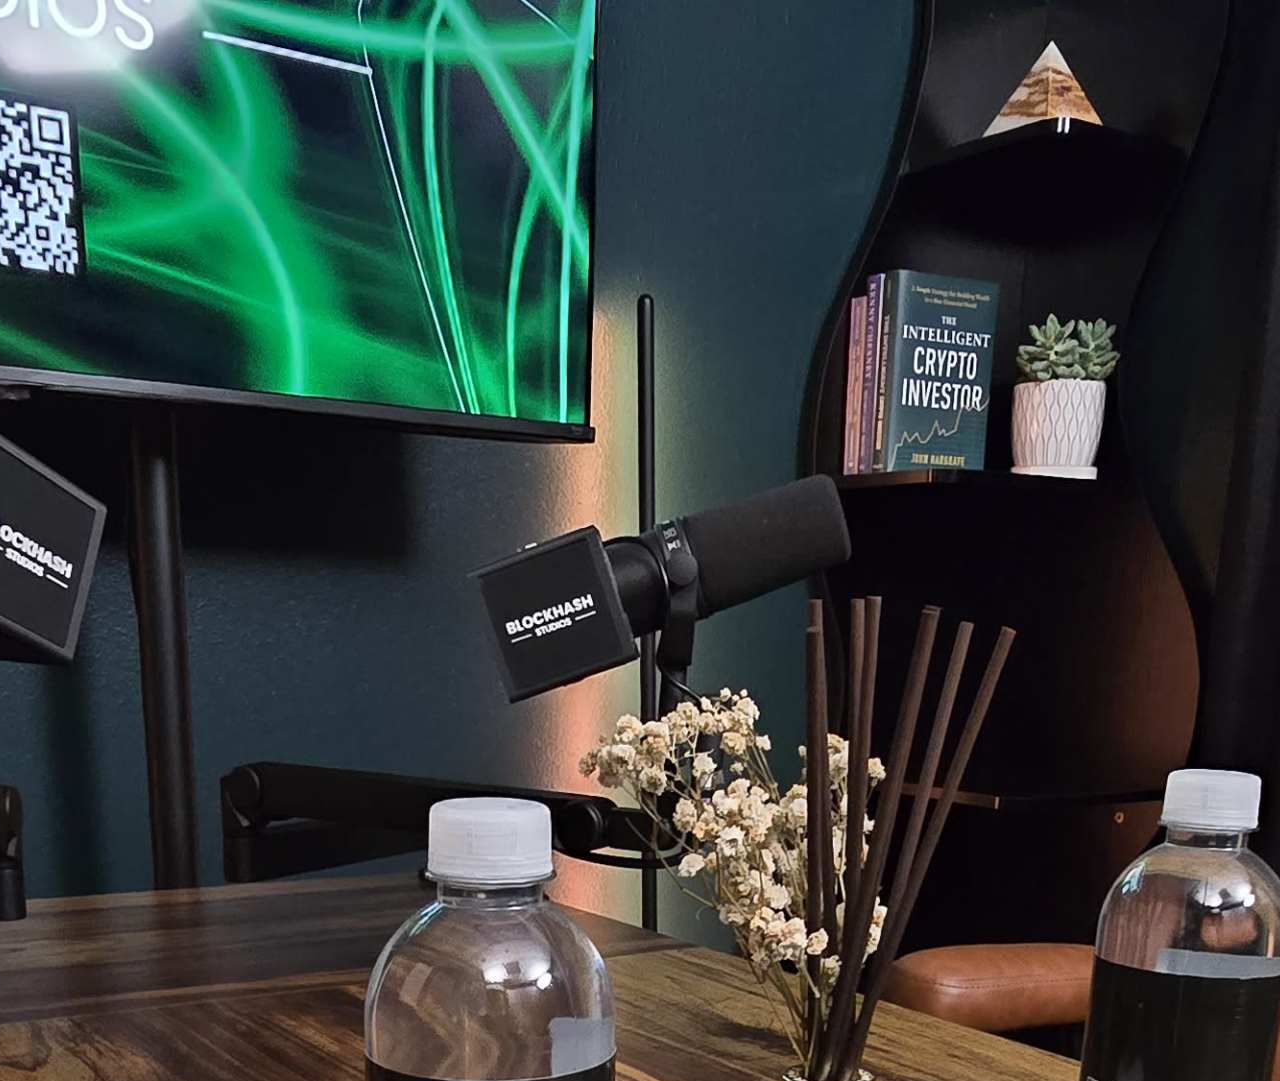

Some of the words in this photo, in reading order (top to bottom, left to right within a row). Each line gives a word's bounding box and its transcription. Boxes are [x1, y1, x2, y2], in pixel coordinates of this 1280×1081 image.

[902, 324, 992, 348] INTELLIGENT
[913, 346, 978, 380] CRYPTO
[901, 378, 983, 411] INVESTOR
[5, 547, 44, 577] STUDIOS
[505, 593, 594, 635] BLOCKHASH
[535, 617, 572, 637] STUDIOS
